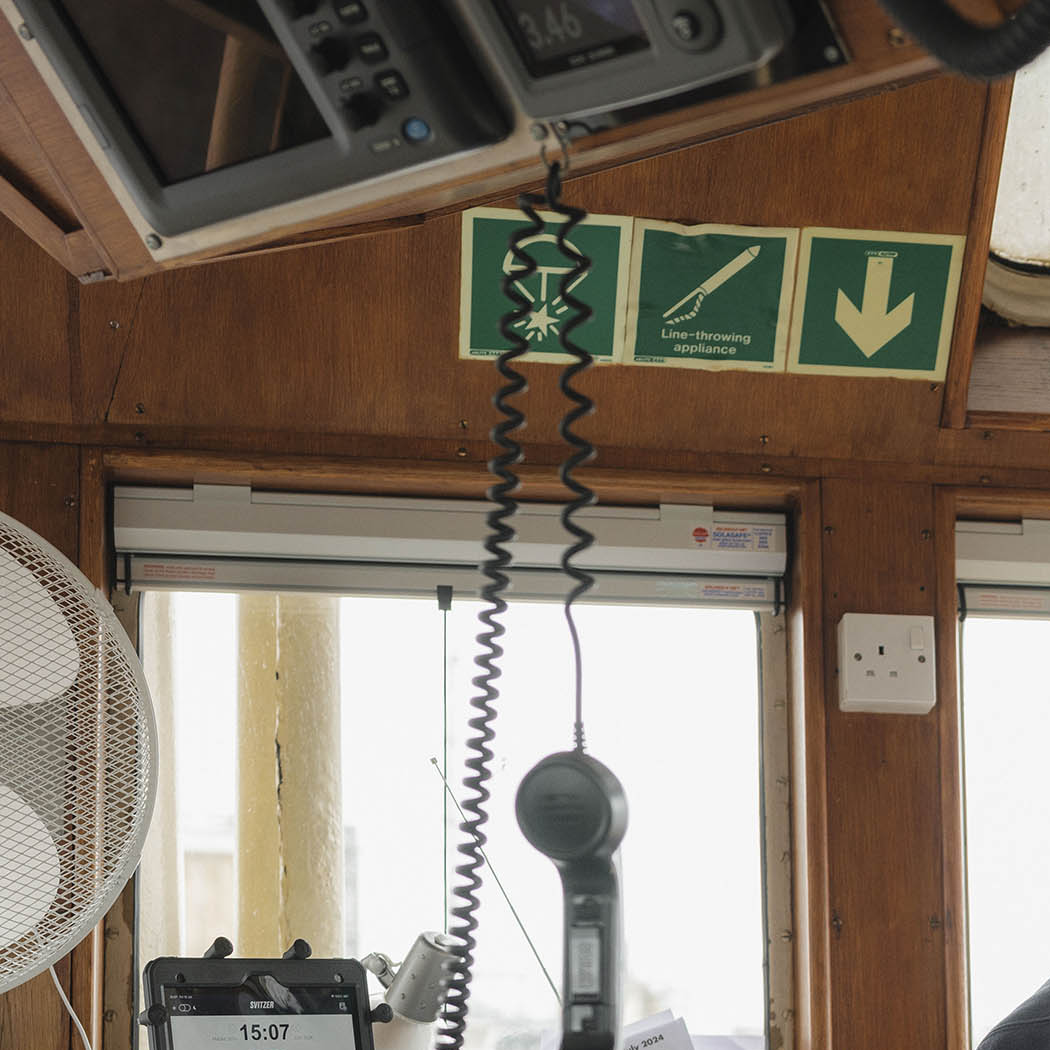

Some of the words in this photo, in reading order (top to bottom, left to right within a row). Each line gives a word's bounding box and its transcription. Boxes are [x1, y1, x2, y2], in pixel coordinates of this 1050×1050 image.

[661, 328, 751, 344] Line-throwing
[673, 342, 737, 354] appliance
[250, 1001, 274, 1009] SVITZER
[240, 1024, 289, 1040] 15:07
[641, 1034, 664, 1048] 2024
